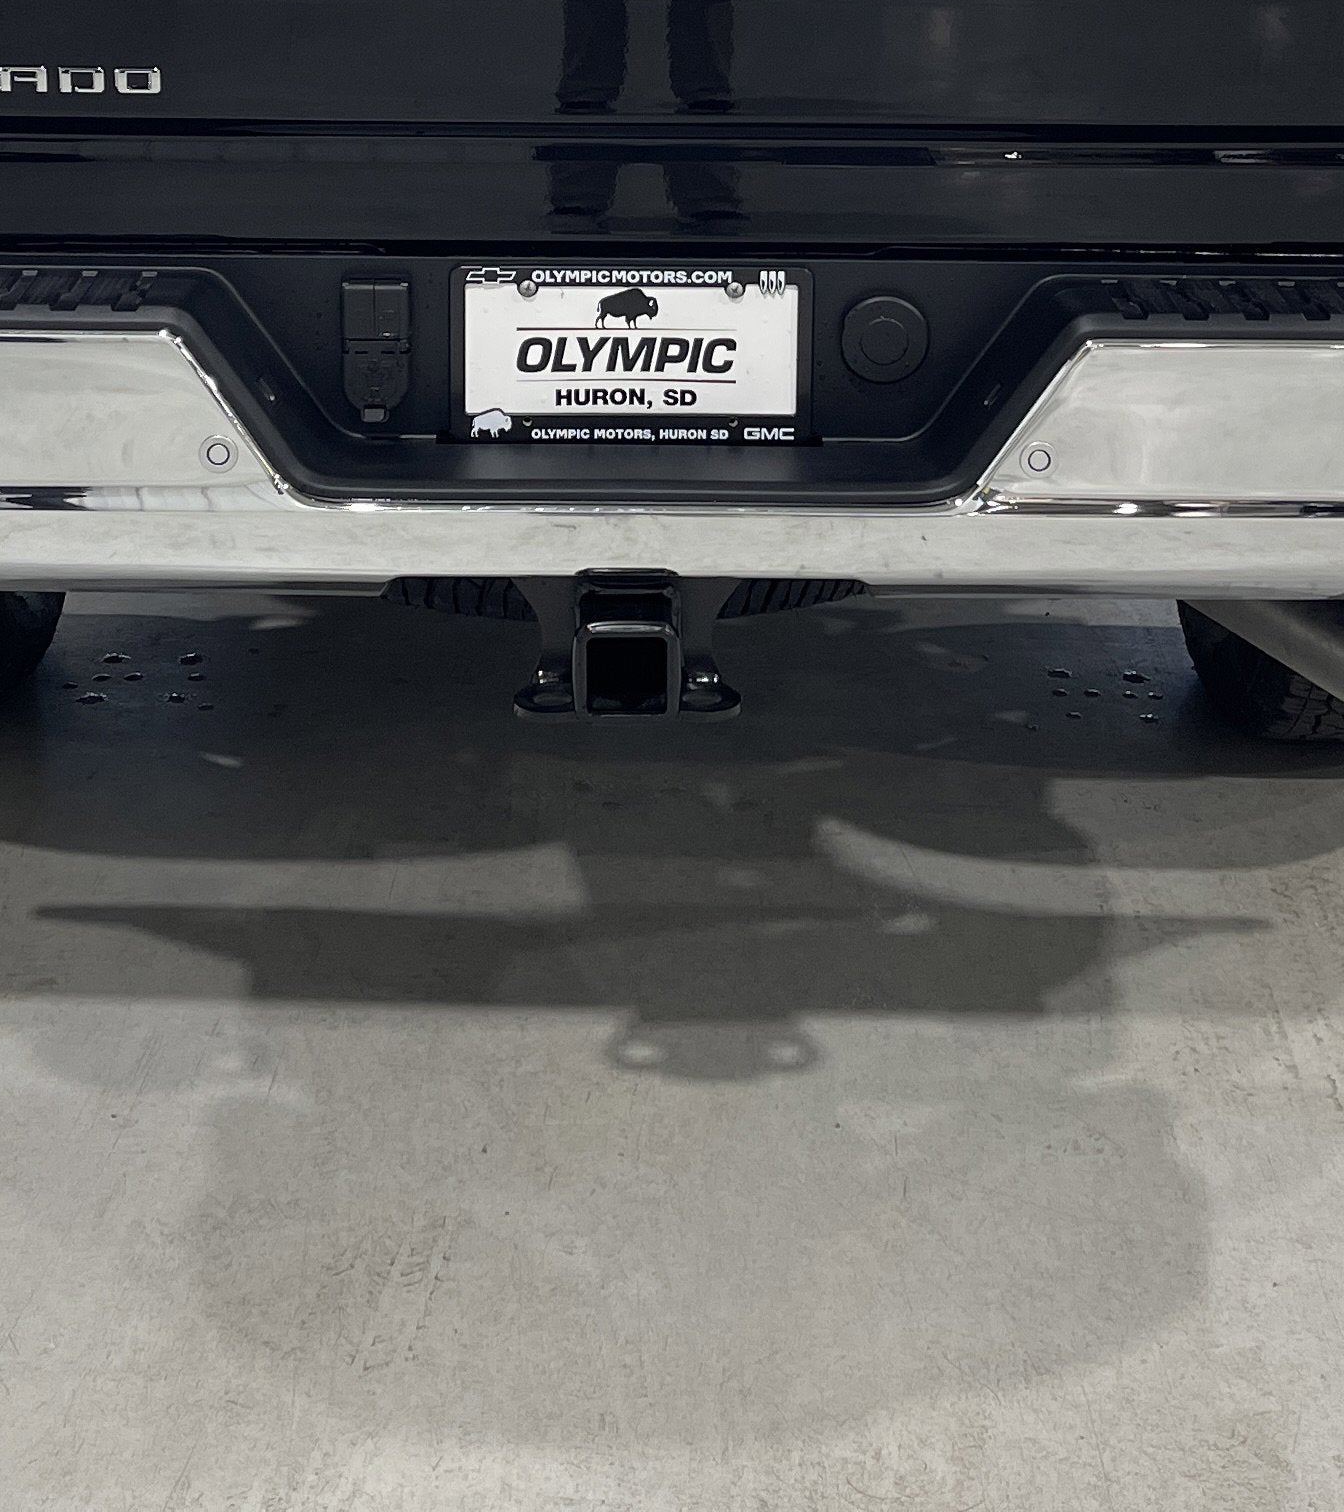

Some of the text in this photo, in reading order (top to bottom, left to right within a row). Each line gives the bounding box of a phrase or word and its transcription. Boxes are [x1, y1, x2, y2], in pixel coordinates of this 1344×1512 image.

[531, 269, 732, 284] OLYMPICMOTORS.COM
[516, 336, 737, 374] OLYMPIC
[555, 388, 697, 409] HURON, SD
[531, 428, 729, 441] OLYMPIC MOTORS, HURON SD
[743, 427, 795, 441] GMC
